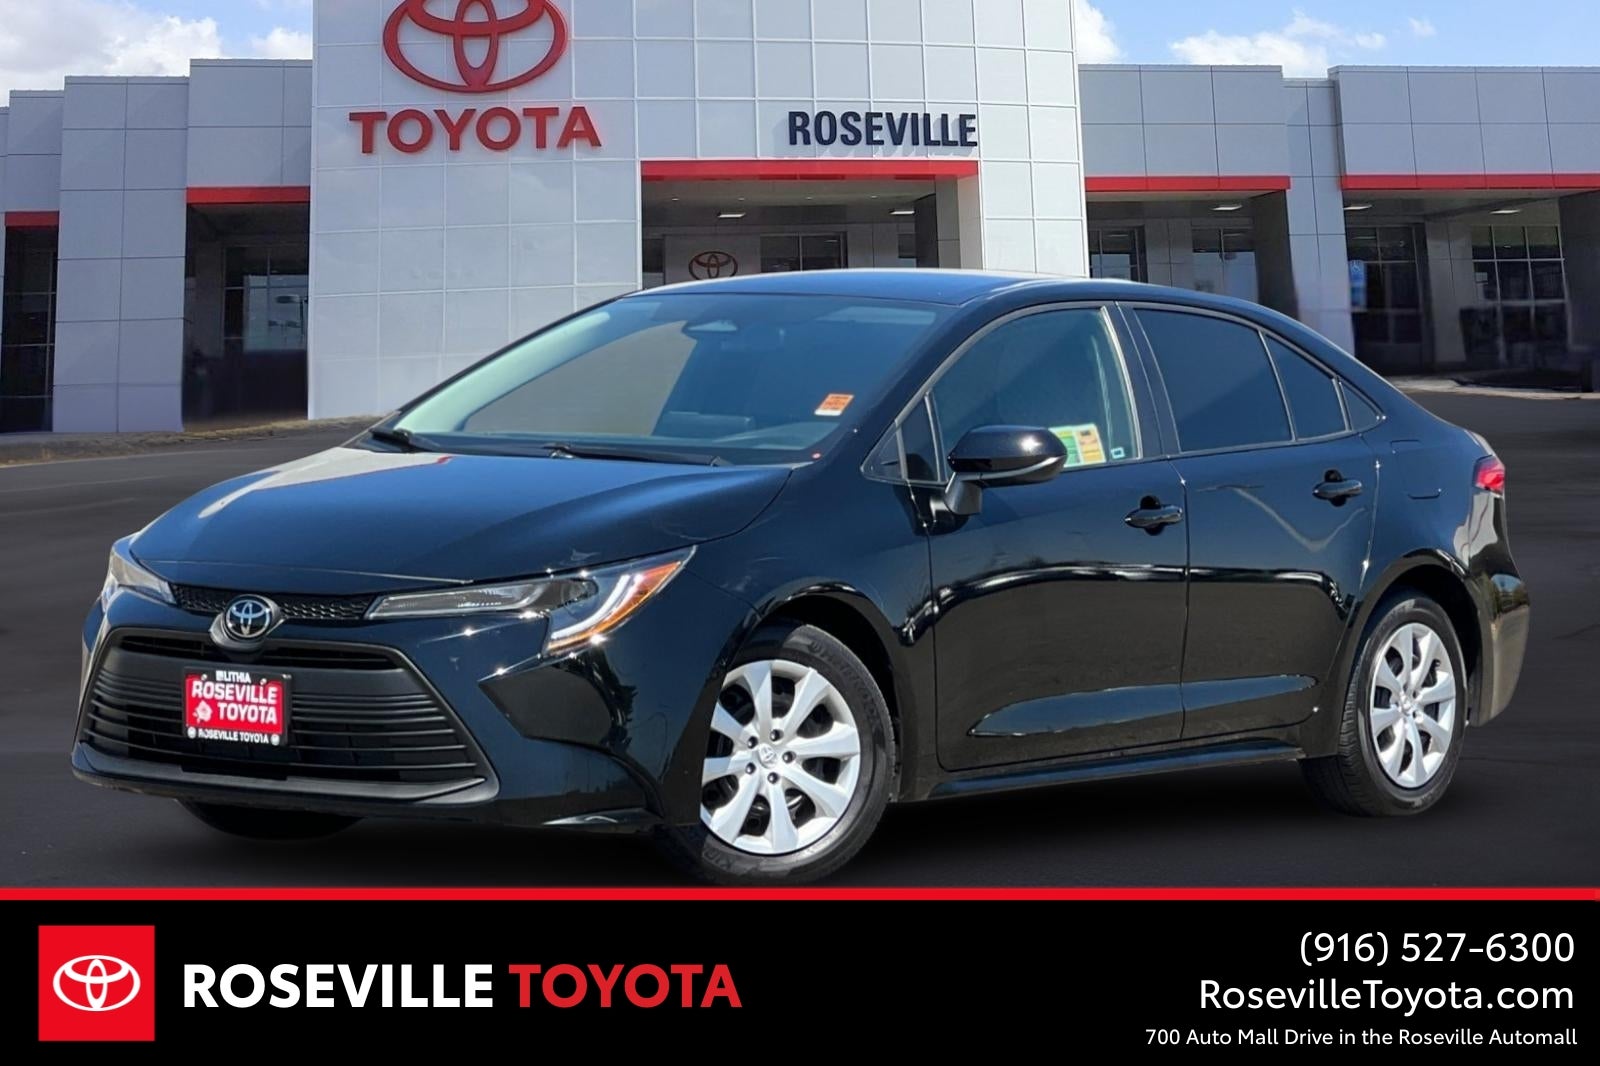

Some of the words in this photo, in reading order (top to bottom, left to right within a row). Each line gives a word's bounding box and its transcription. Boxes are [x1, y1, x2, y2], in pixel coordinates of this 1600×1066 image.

[349, 106, 602, 154] TOYOTA
[788, 111, 978, 147] ROSEVILLE
[191, 680, 278, 705] ROSEVILLE
[217, 702, 278, 725] TOYOTA
[198, 728, 239, 742] ROSEVILLE
[239, 731, 270, 744] TOYOTA
